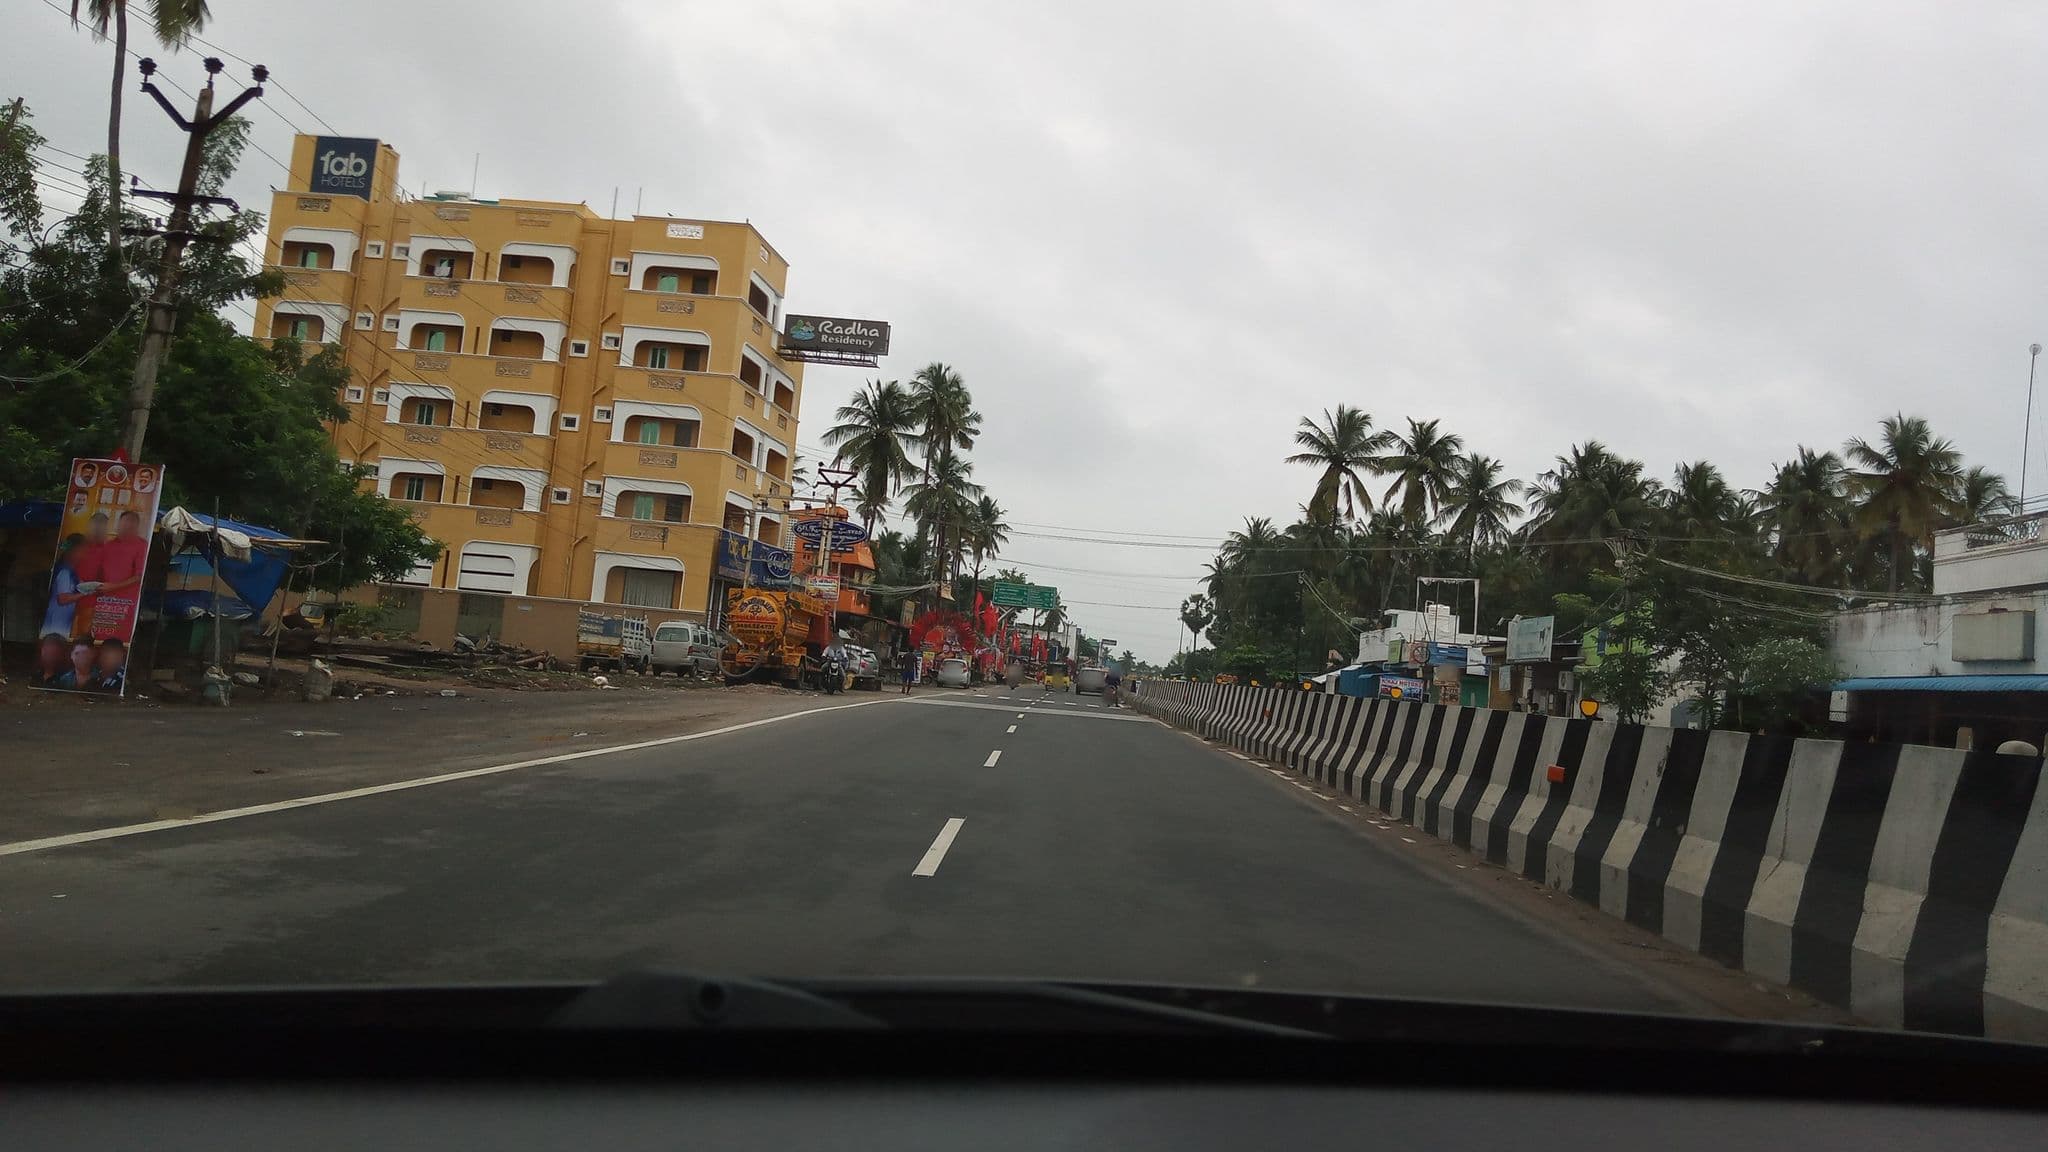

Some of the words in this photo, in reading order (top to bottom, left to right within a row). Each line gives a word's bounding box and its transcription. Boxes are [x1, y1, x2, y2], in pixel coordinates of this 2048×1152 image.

[320, 150, 367, 177] fab
[321, 176, 365, 188] HOTELS
[818, 320, 880, 337] Radha
[821, 334, 874, 348] Residency
